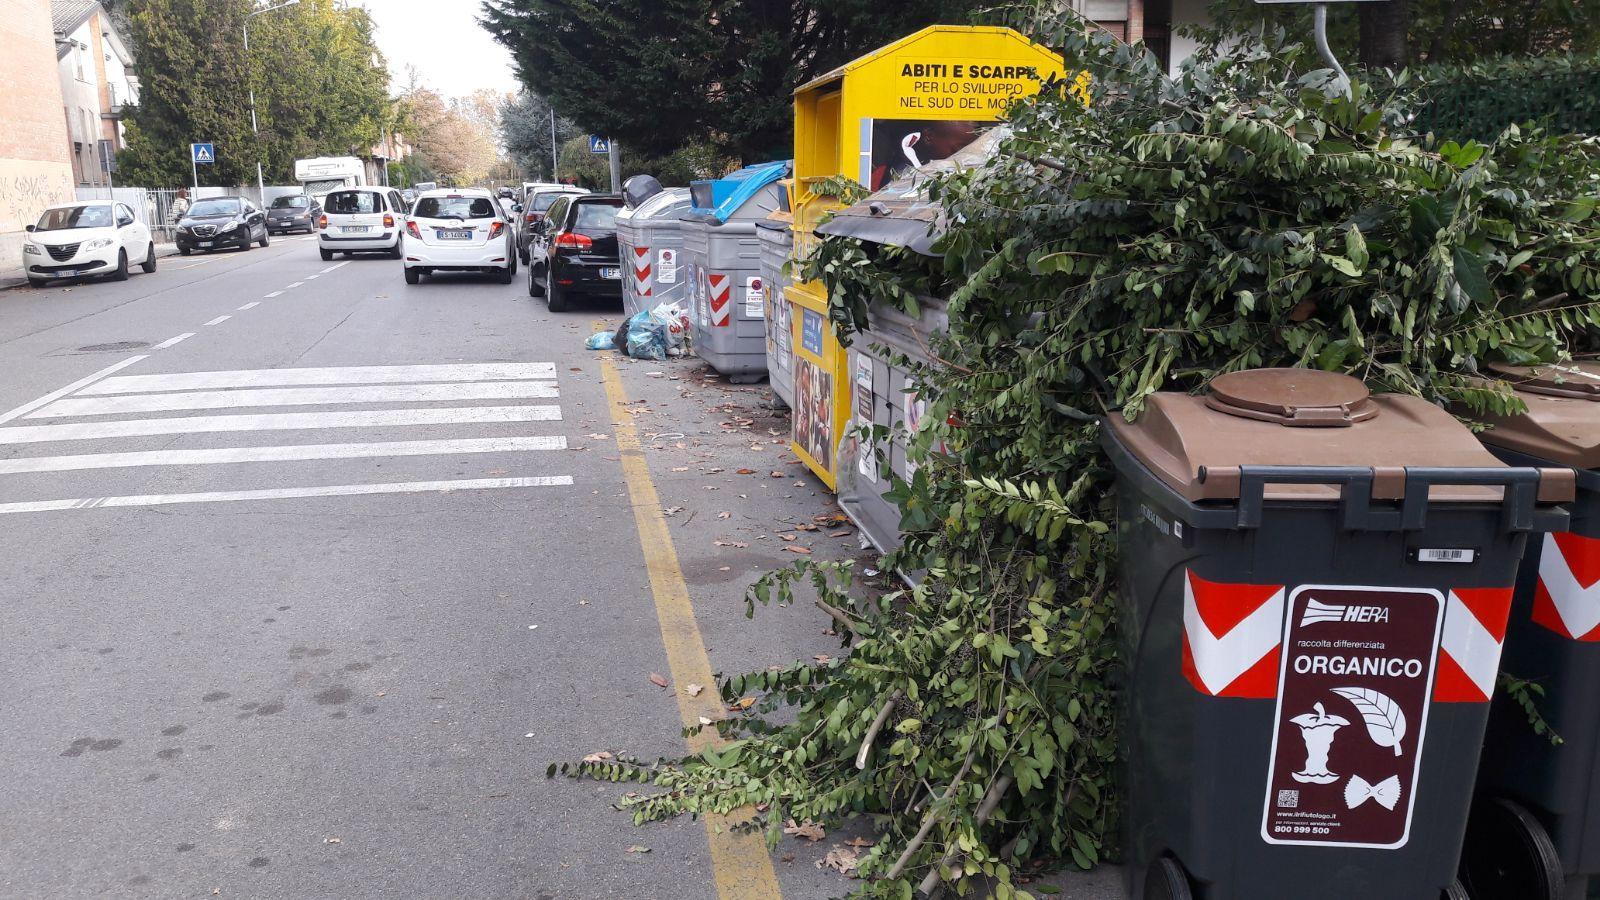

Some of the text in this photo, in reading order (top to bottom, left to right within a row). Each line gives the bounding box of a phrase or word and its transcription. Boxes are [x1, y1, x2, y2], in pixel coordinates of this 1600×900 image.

[901, 64, 947, 78] ABITI
[953, 65, 963, 78] E
[914, 82, 1023, 95] PER LO SVILUPPO
[900, 97, 924, 108] NEL
[927, 97, 954, 109] SUD
[959, 98, 983, 109] DEL
[1343, 605, 1389, 623] HERA
[1297, 639, 1385, 650] raccolta differenziata
[1294, 655, 1423, 678] ORGANICO
[1293, 826, 1311, 834] 999
